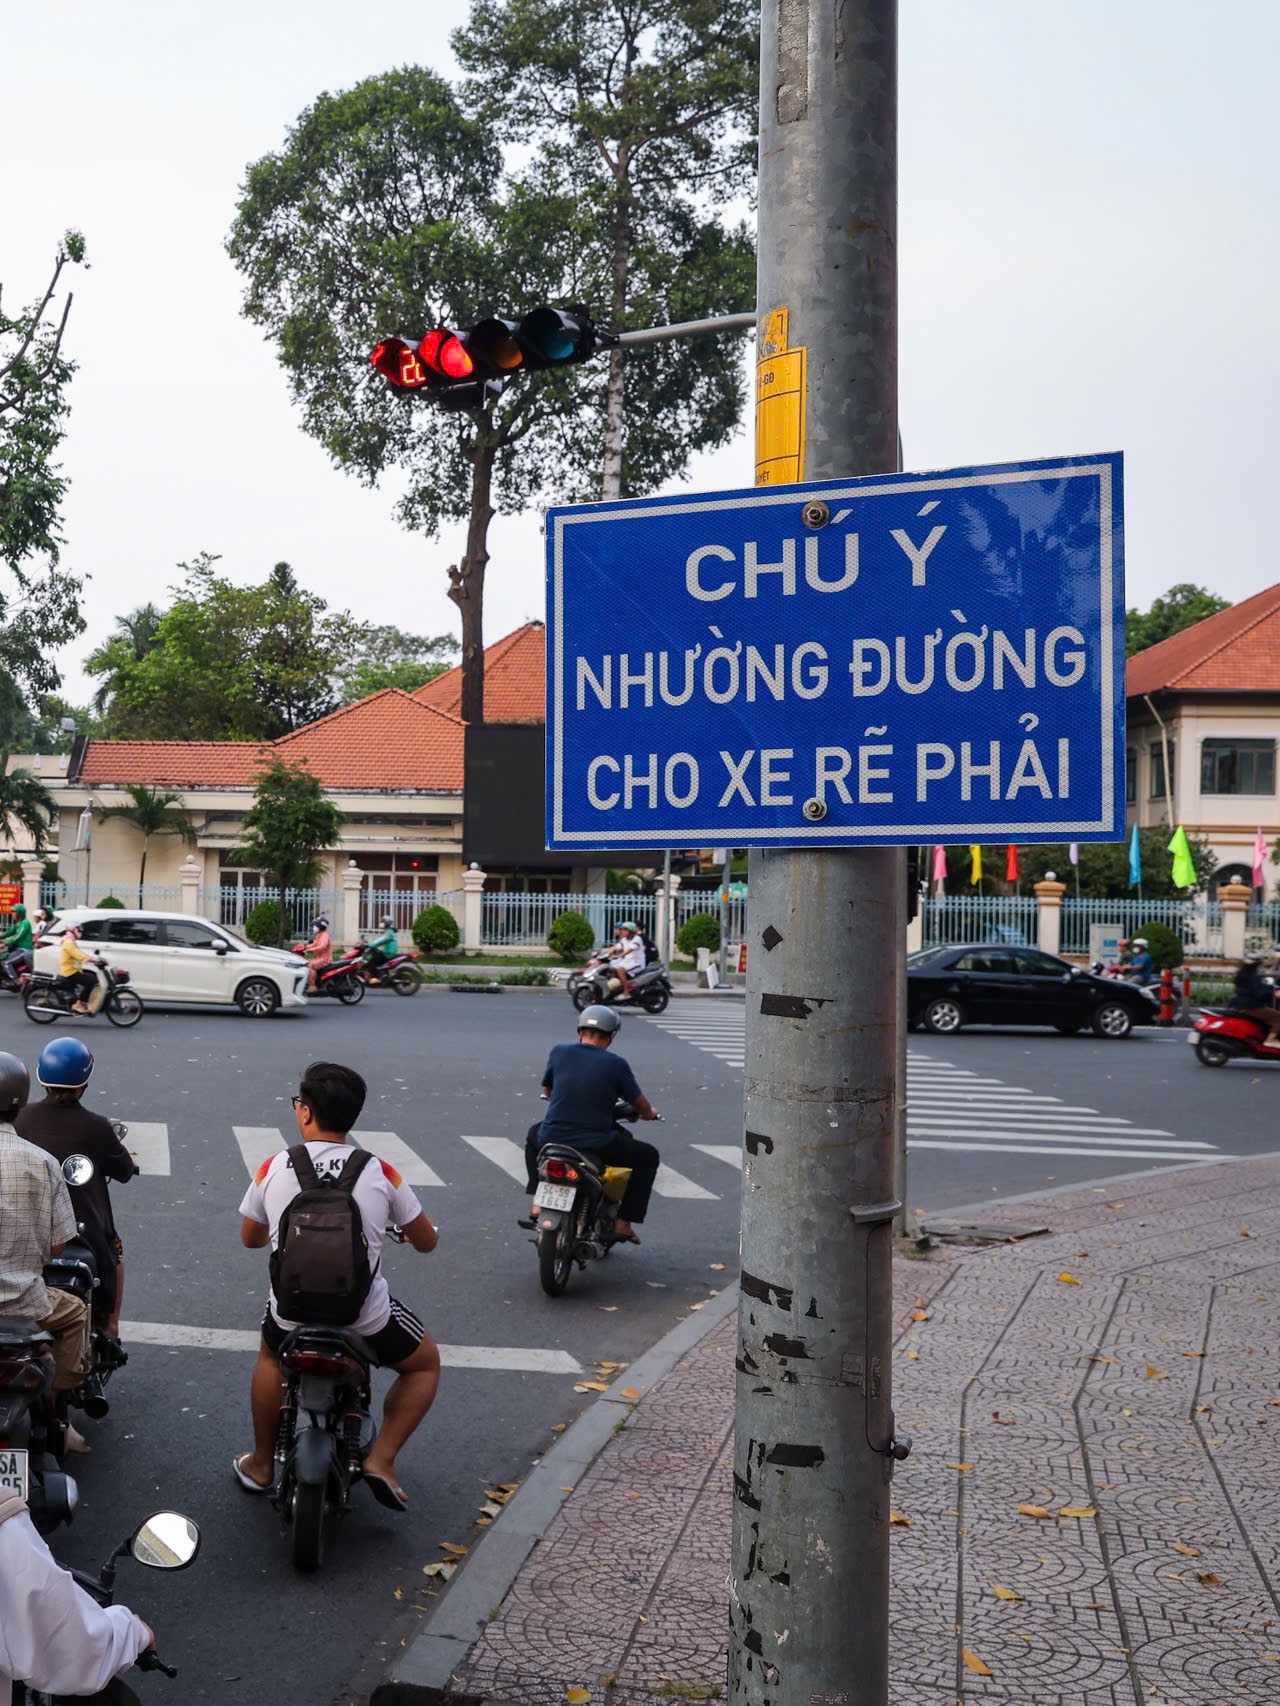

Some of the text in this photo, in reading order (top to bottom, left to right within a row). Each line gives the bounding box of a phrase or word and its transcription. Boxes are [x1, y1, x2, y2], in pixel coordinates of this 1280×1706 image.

[685, 501, 948, 602] CHÚ Ý
[576, 609, 1087, 711] NHƯỜNG ĐƯỜNG
[587, 712, 1070, 811] CHO XE RẼ PHẢI
